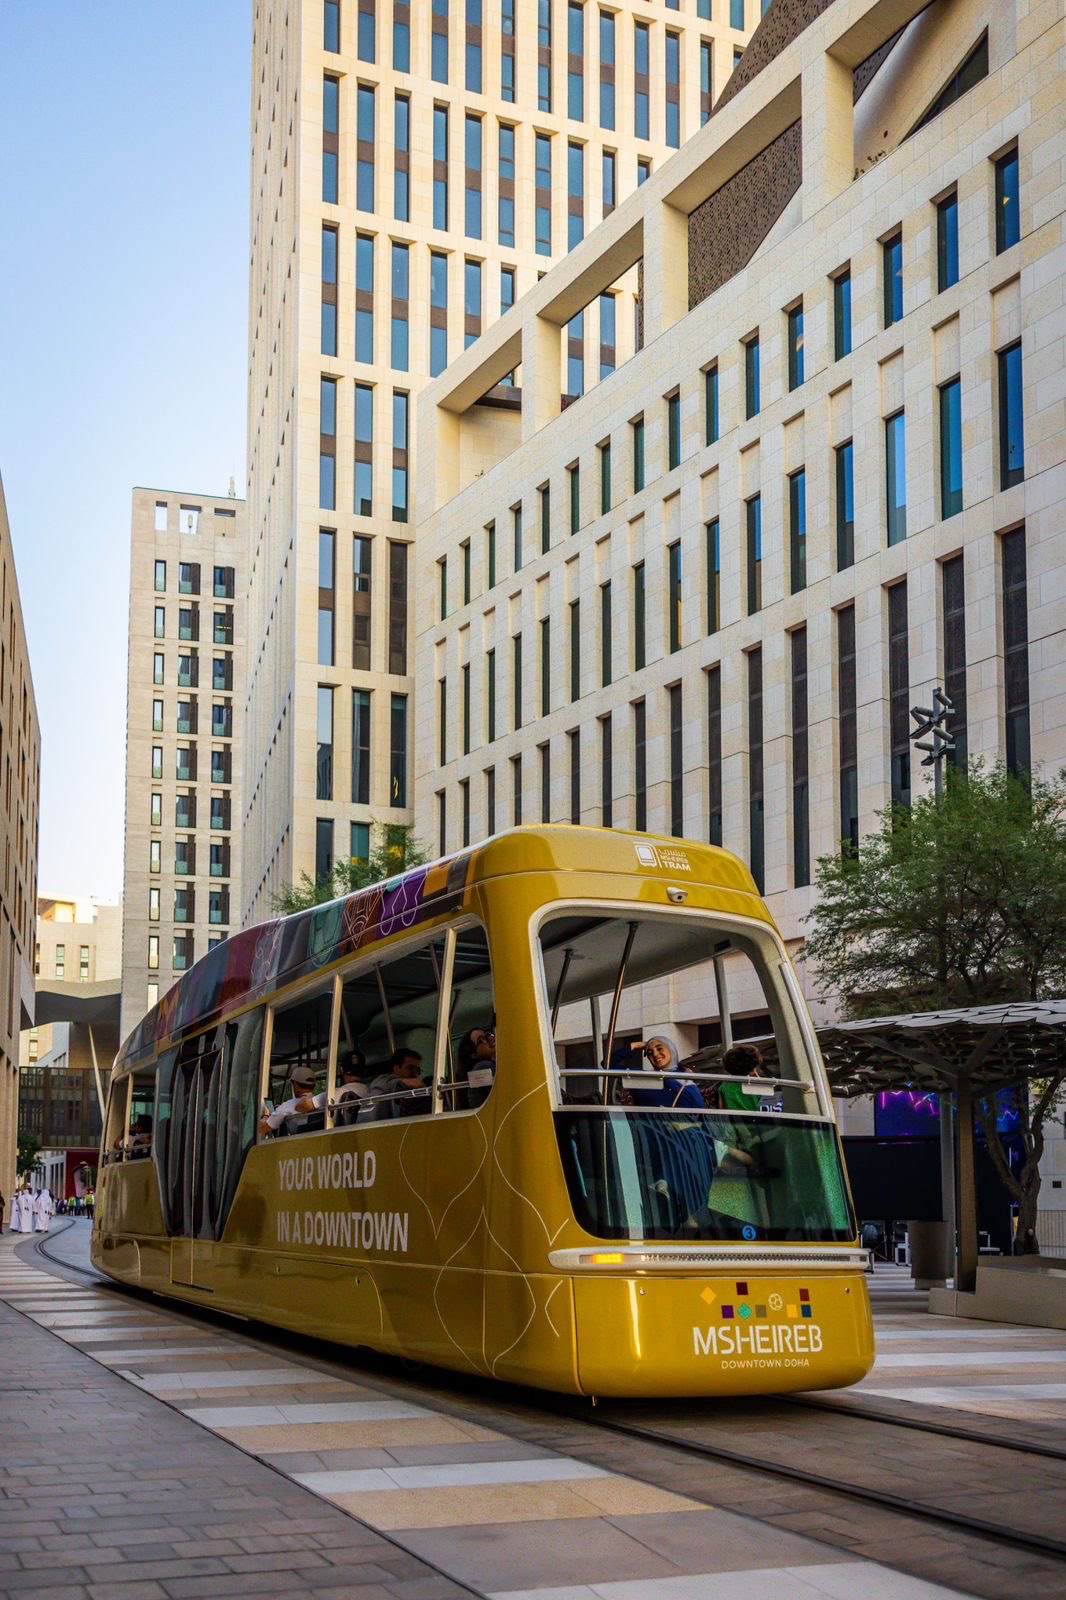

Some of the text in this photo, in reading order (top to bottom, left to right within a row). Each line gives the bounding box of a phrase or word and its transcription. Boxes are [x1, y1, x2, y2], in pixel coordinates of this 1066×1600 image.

[662, 860, 691, 871] TRAM
[279, 1150, 376, 1191] YOUR WORLD
[277, 1211, 408, 1252] IN A DOWNTOWN
[693, 1325, 823, 1355] MSHEIREB
[721, 1358, 810, 1369] DOWNTOWN DOHA
